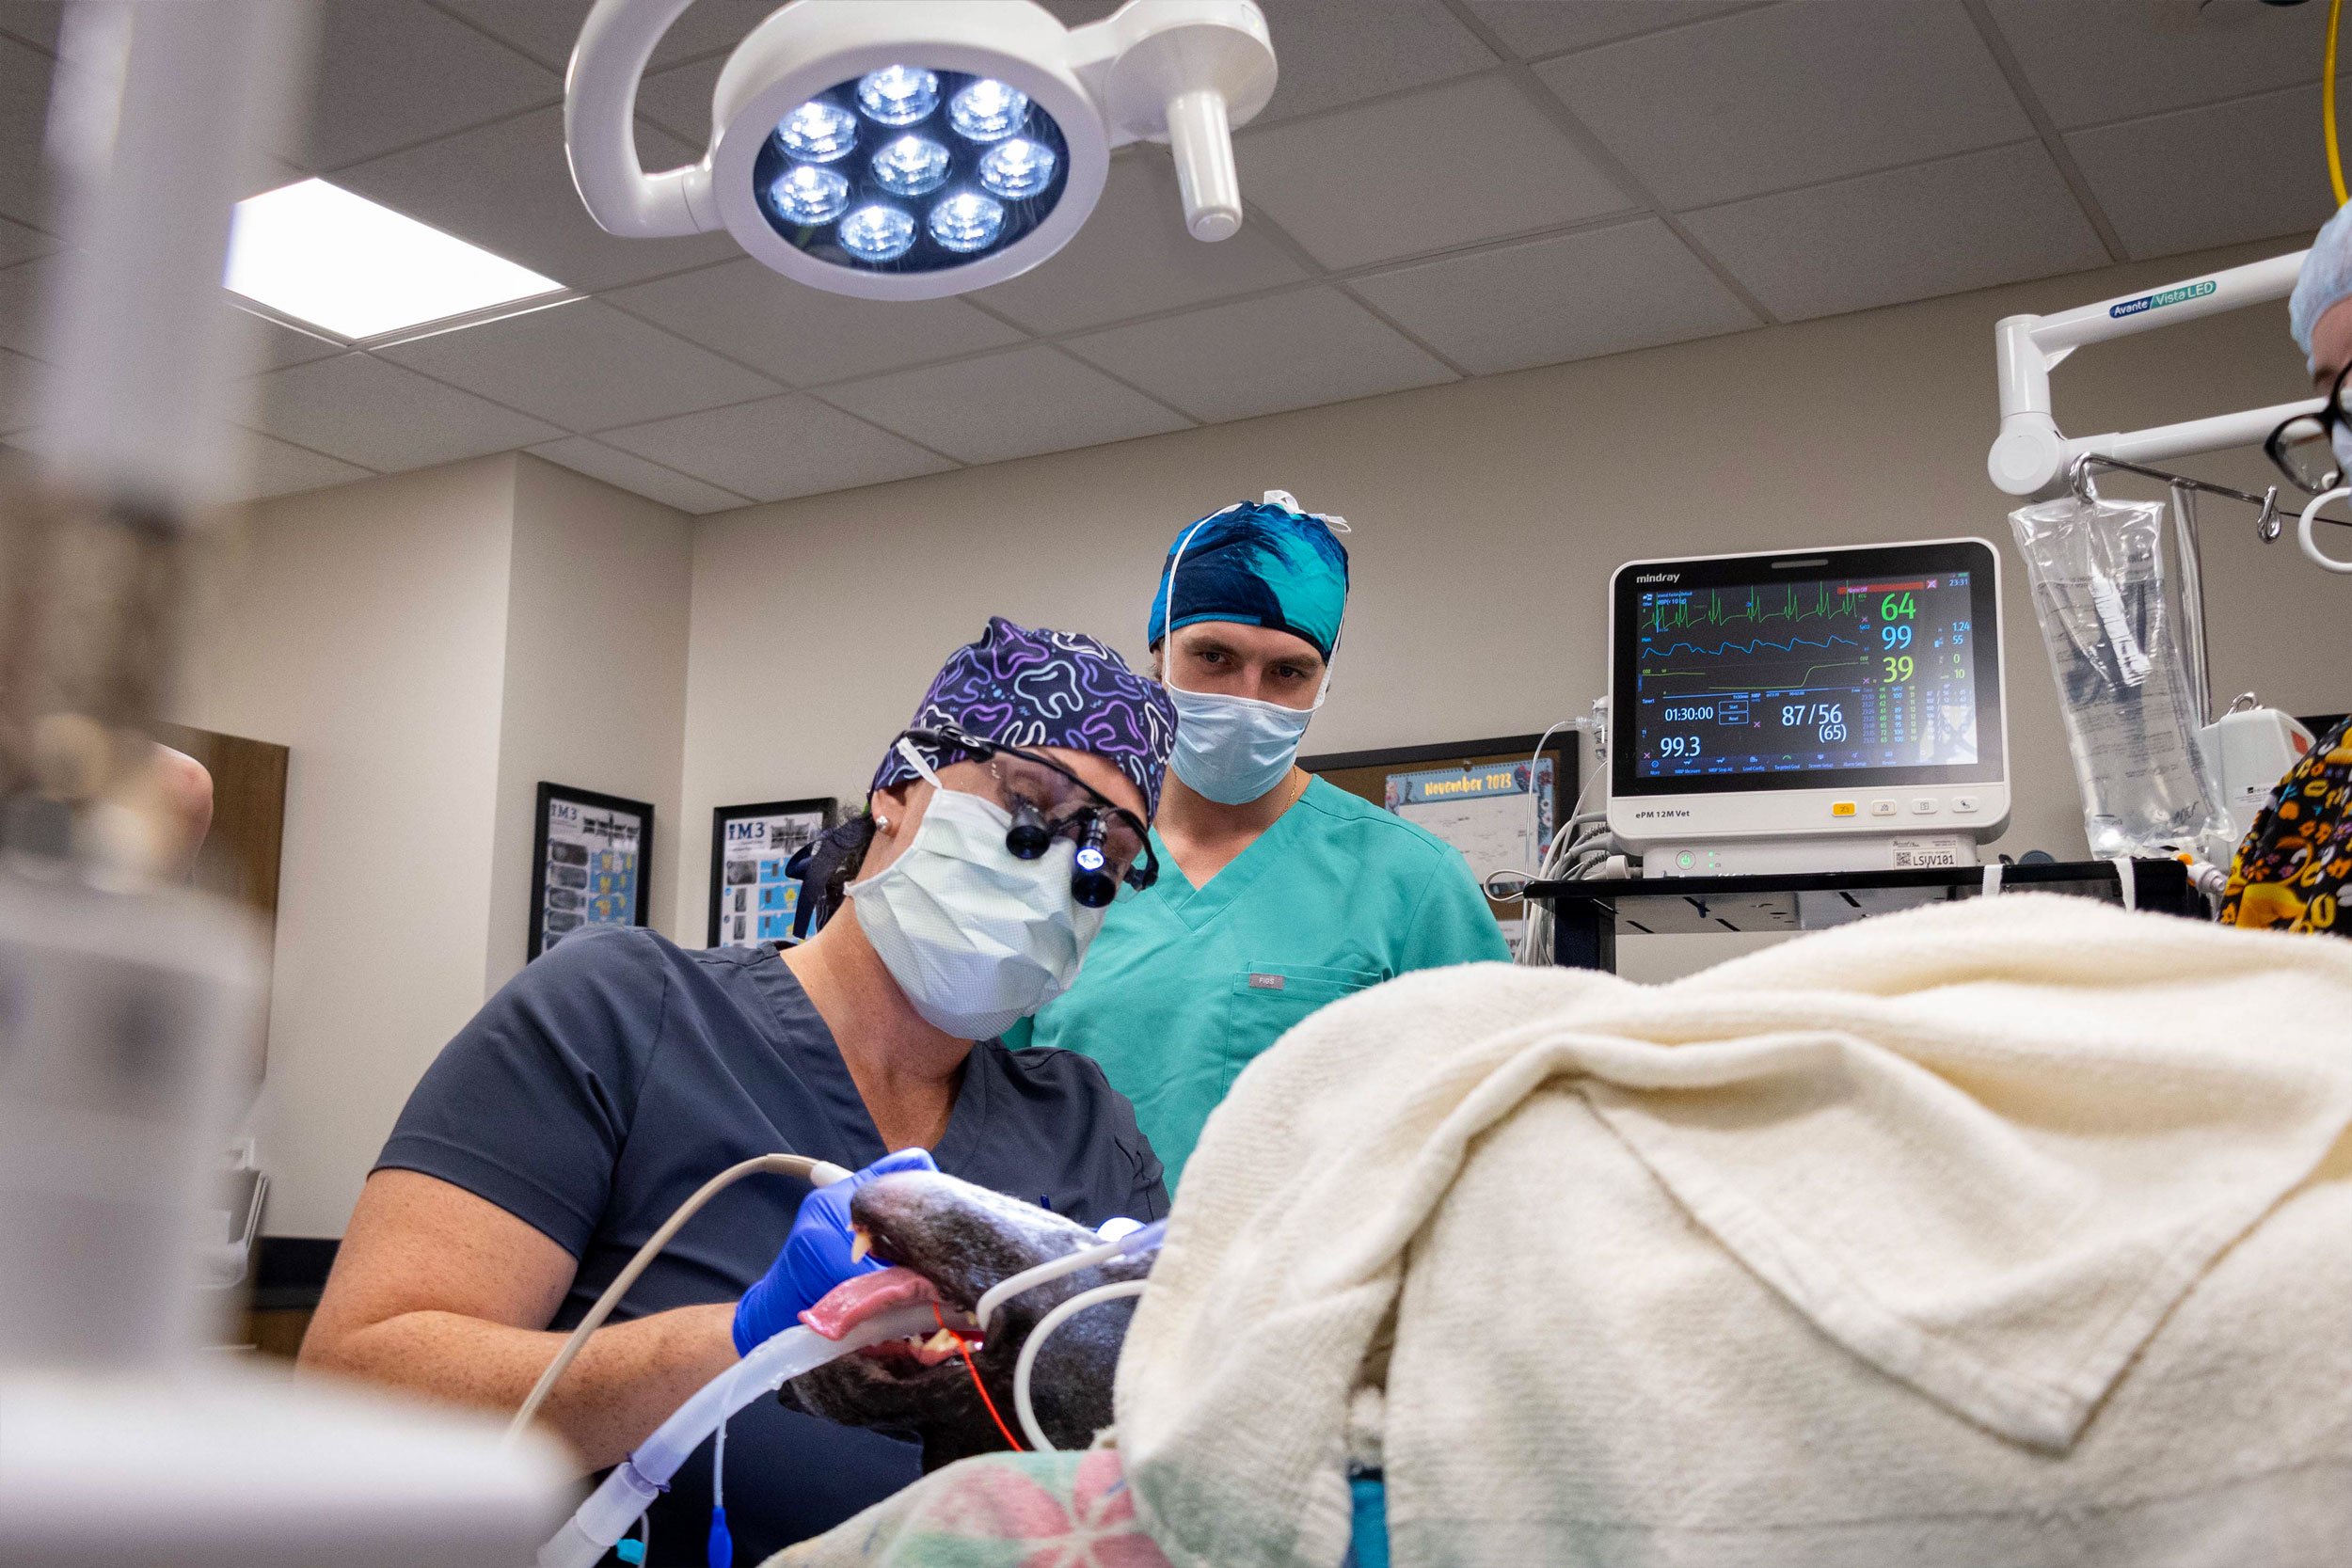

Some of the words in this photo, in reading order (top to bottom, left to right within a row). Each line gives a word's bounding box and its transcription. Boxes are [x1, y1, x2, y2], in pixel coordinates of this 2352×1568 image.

[2155, 291, 2185, 307] Vista
[2187, 282, 2214, 298] LED
[2113, 300, 2149, 317] Avante
[1636, 573, 1680, 584] mindray
[1948, 578, 1969, 587] 23:31
[1881, 592, 1917, 622] 64
[1952, 621, 1971, 632] 1.24
[1882, 625, 1913, 651] 99
[1952, 635, 1964, 645] 55
[1953, 654, 1961, 664] 0
[1883, 655, 1915, 684] 39
[1954, 669, 1965, 679] 10
[1664, 706, 1714, 721] 01:30:00
[1819, 722, 1847, 743] (65)
[1660, 736, 1701, 758] 99.3
[1424, 775, 1483, 796] November
[1486, 772, 1512, 790] 2023
